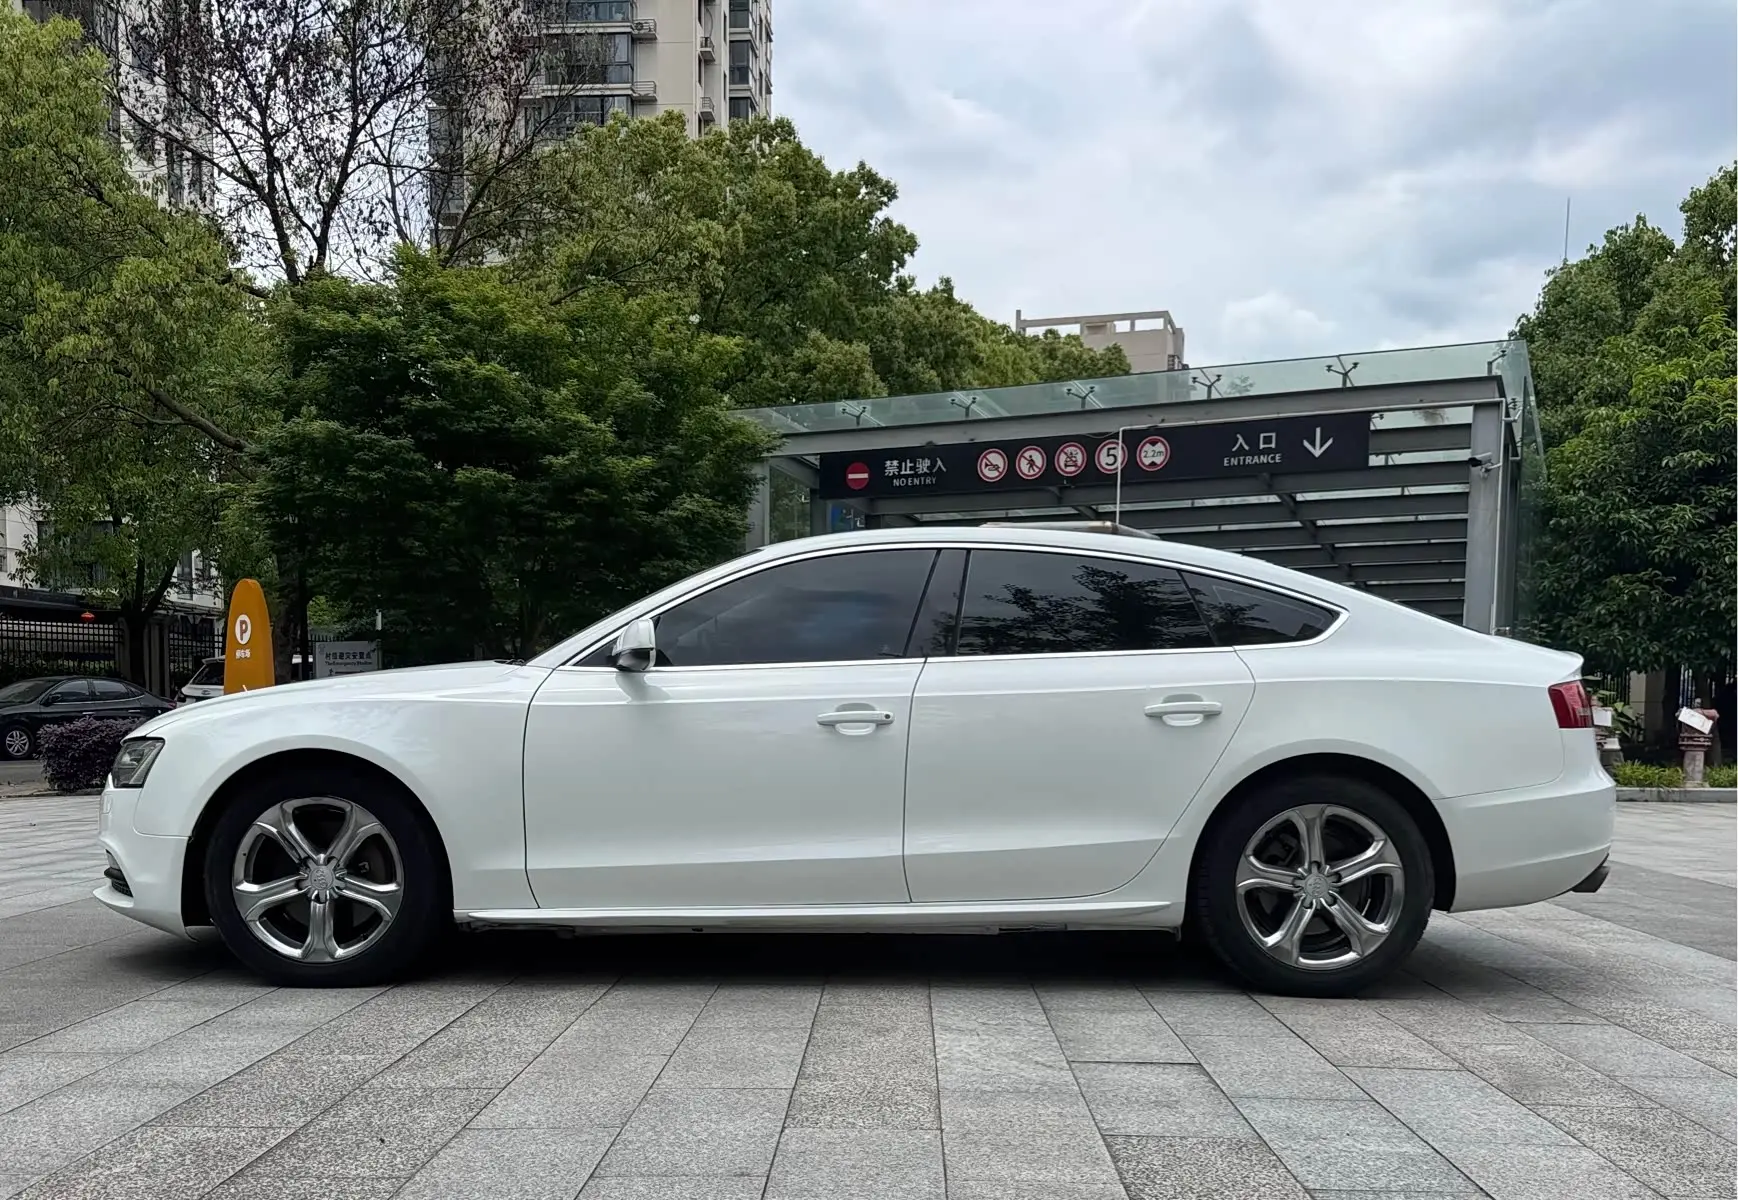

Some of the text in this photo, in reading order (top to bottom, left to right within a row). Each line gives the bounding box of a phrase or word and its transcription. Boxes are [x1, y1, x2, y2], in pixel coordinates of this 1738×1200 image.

[1231, 432, 1277, 452] 入口
[1105, 447, 1118, 467] 5
[1143, 449, 1165, 459] 2.2m
[1223, 453, 1283, 467] ENTRANCE
[884, 457, 947, 476] 禁止驶入
[239, 619, 249, 641] P
